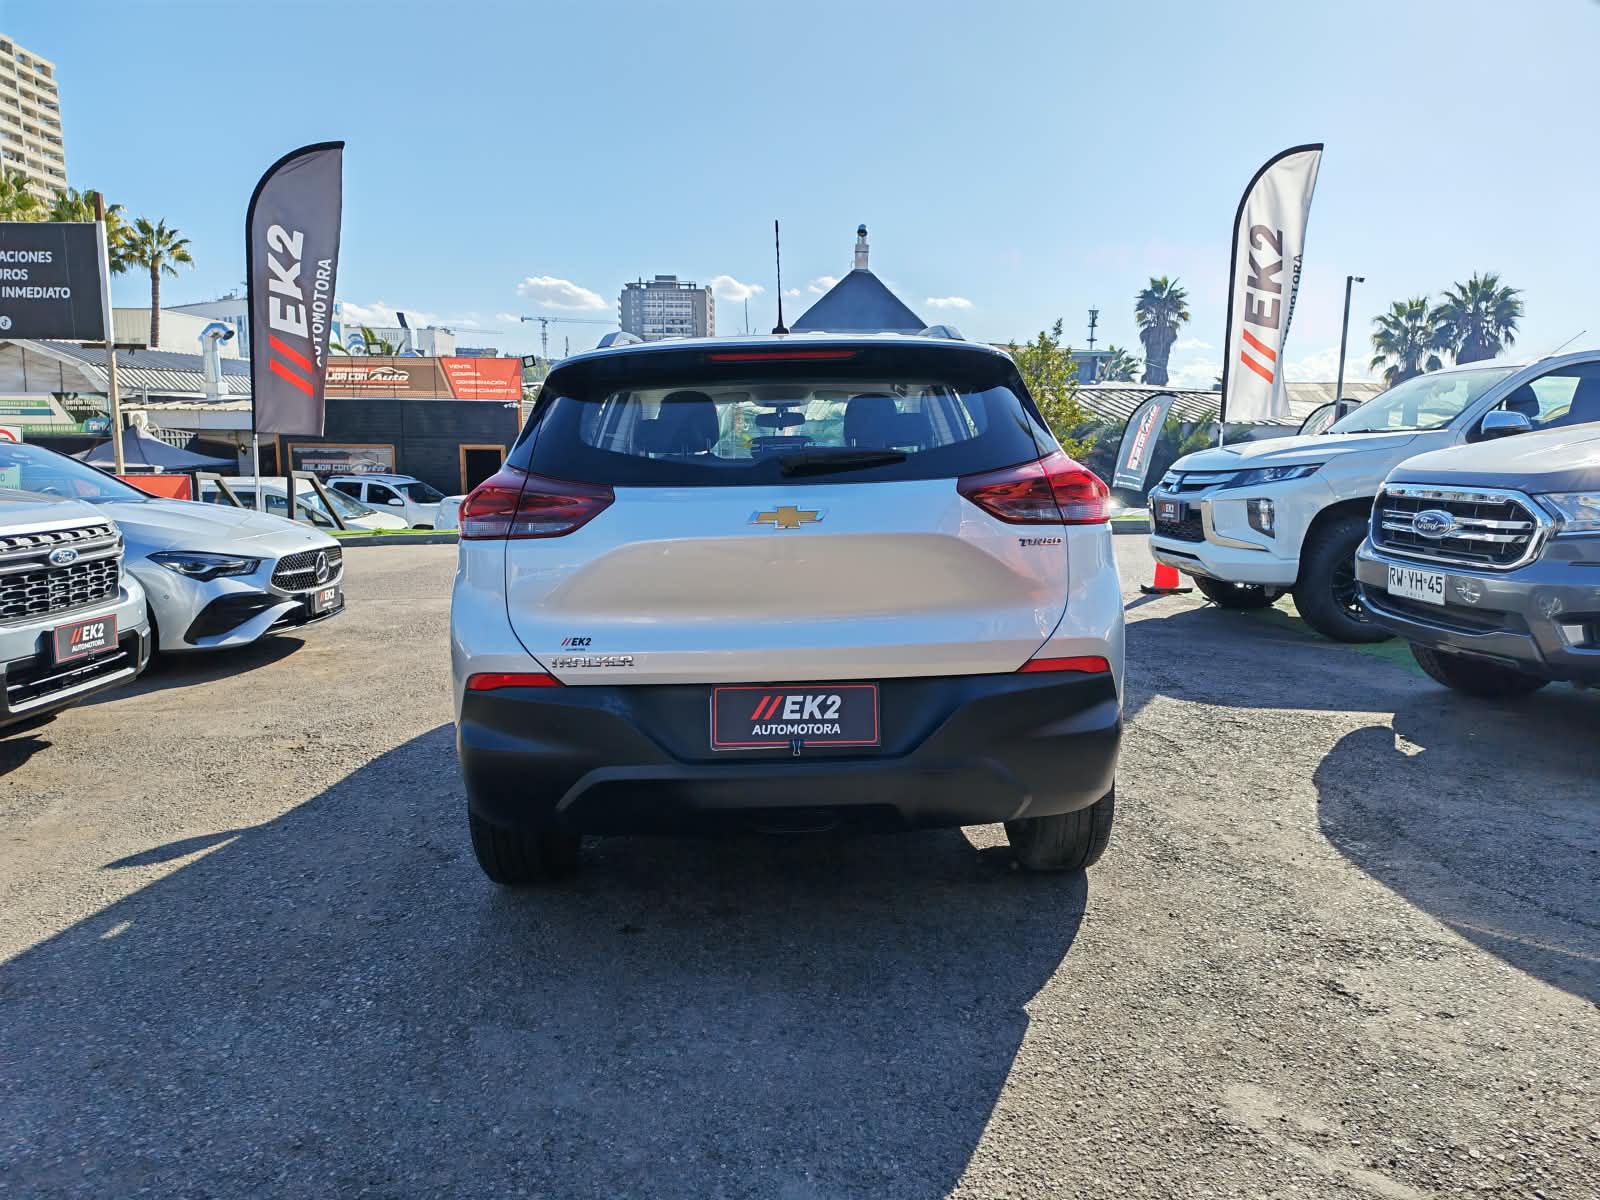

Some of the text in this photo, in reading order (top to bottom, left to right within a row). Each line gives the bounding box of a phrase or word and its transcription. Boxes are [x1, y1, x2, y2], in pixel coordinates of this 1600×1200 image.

[0, 269, 29, 280] ROS
[267, 225, 308, 338] EK2
[1244, 225, 1283, 329] EK2
[2, 286, 71, 299] INMEDIATO
[82, 622, 104, 641] EK2
[71, 638, 105, 653] AUTOMOTORA
[571, 637, 592, 646] EK2
[782, 695, 842, 721] EK2
[751, 723, 841, 736] AUTOMOTORA
